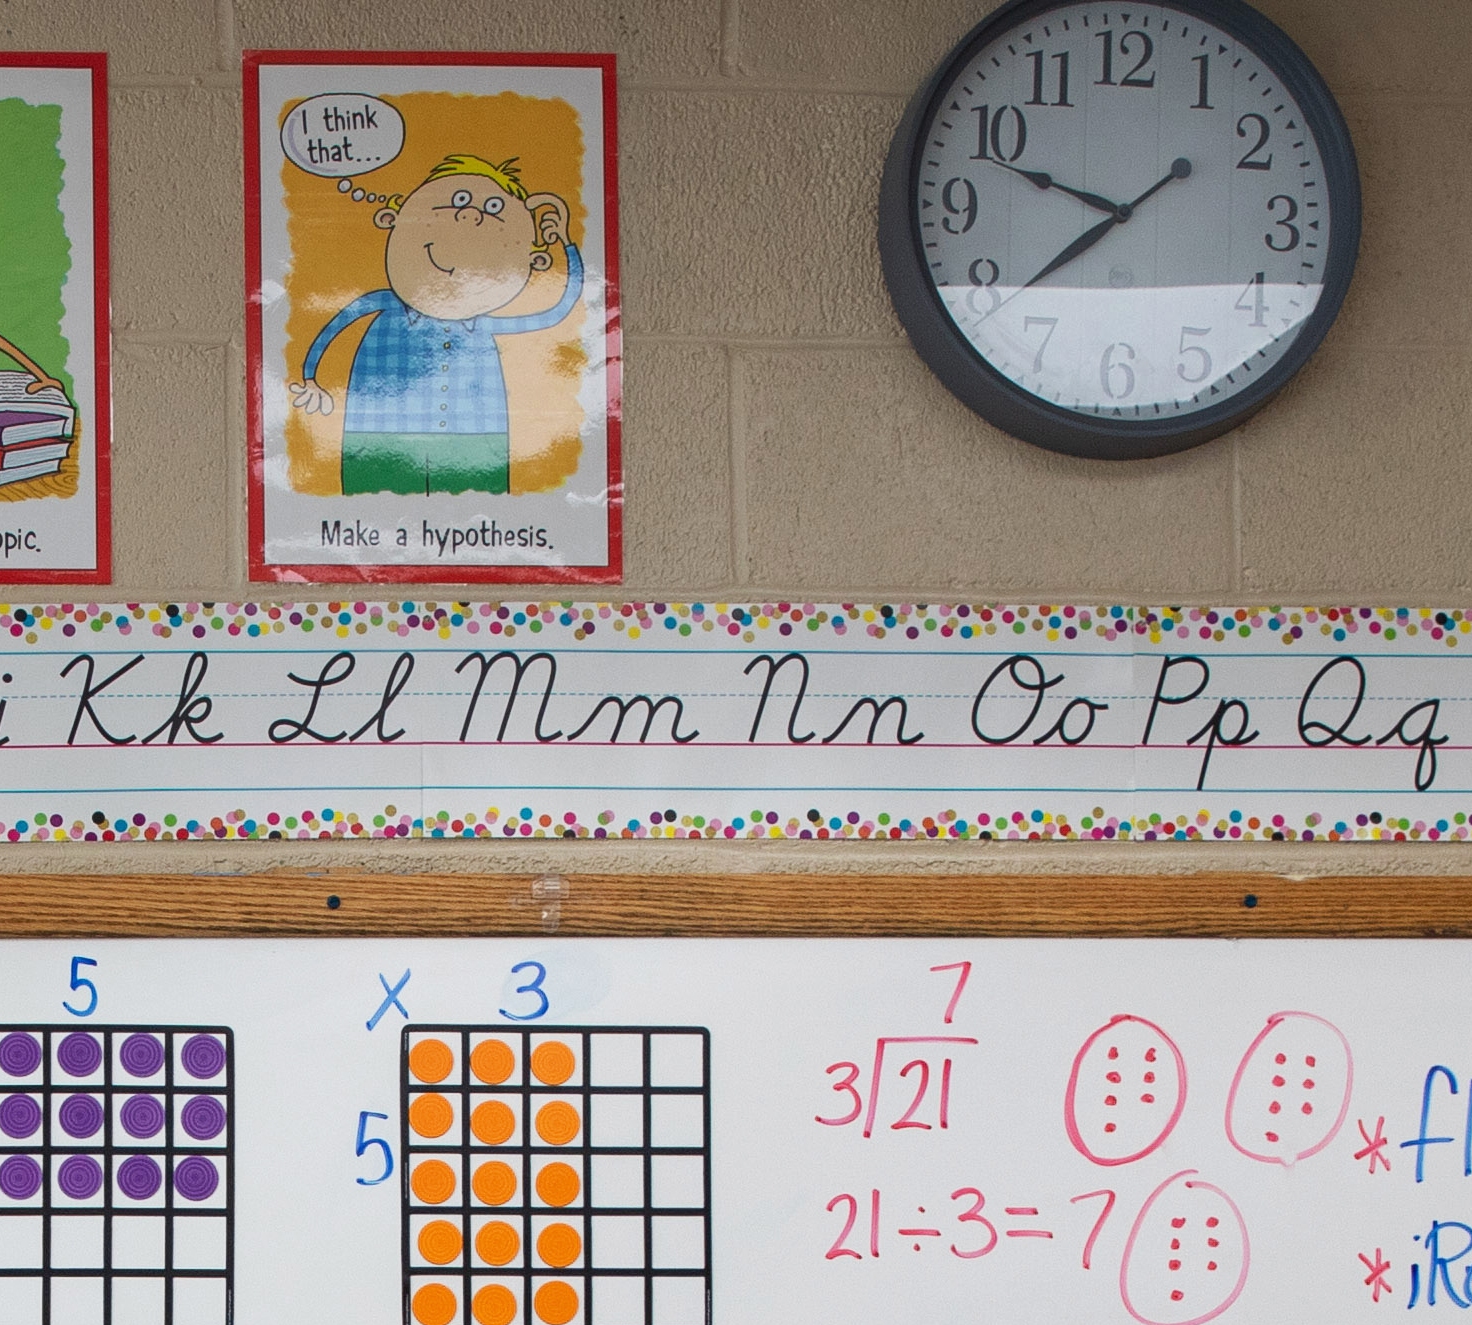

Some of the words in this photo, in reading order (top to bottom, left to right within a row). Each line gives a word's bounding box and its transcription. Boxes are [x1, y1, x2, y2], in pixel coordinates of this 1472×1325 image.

[1093, 30, 1156, 88] 12
[323, 105, 378, 131] think
[321, 521, 379, 547] Make
[396, 528, 407, 546] a
[423, 521, 553, 556] hypothesis.
